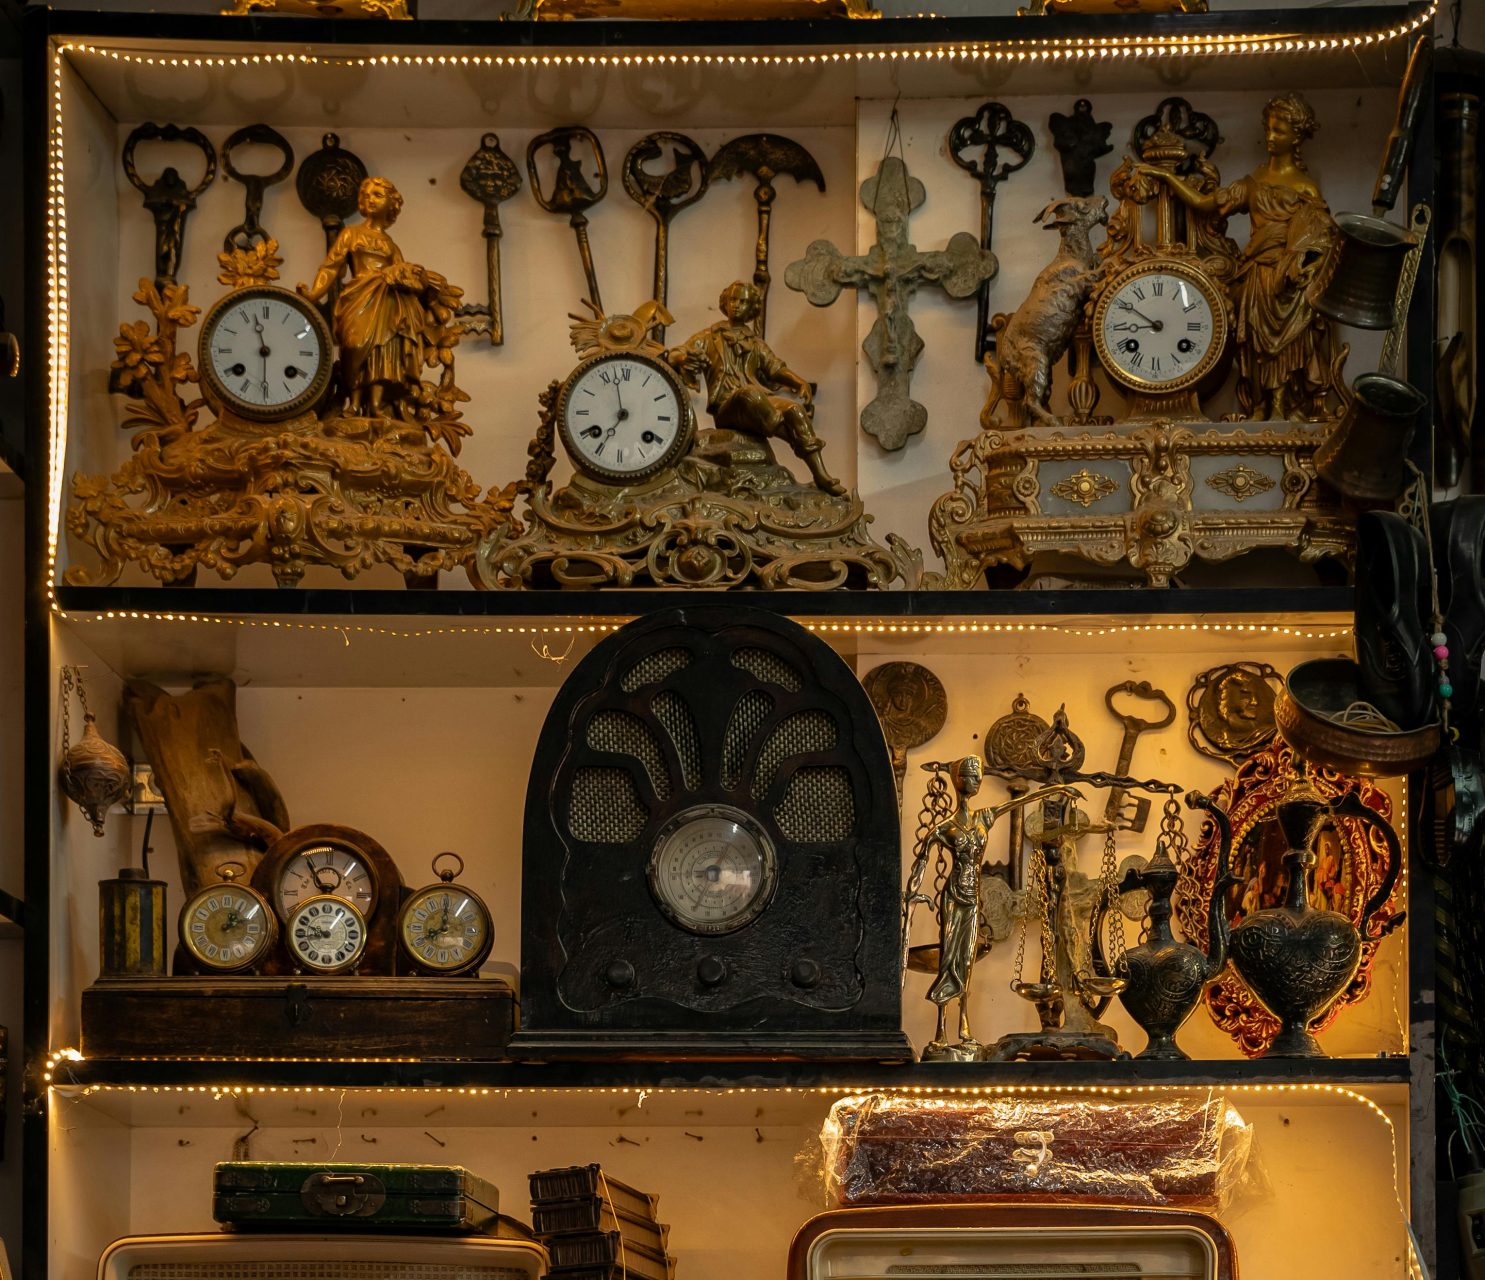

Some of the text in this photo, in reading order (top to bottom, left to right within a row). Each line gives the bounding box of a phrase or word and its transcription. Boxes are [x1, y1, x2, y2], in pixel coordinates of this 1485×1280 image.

[1153, 283, 1163, 296] XII
[1183, 303, 1196, 313] II
[1187, 323, 1201, 331] III
